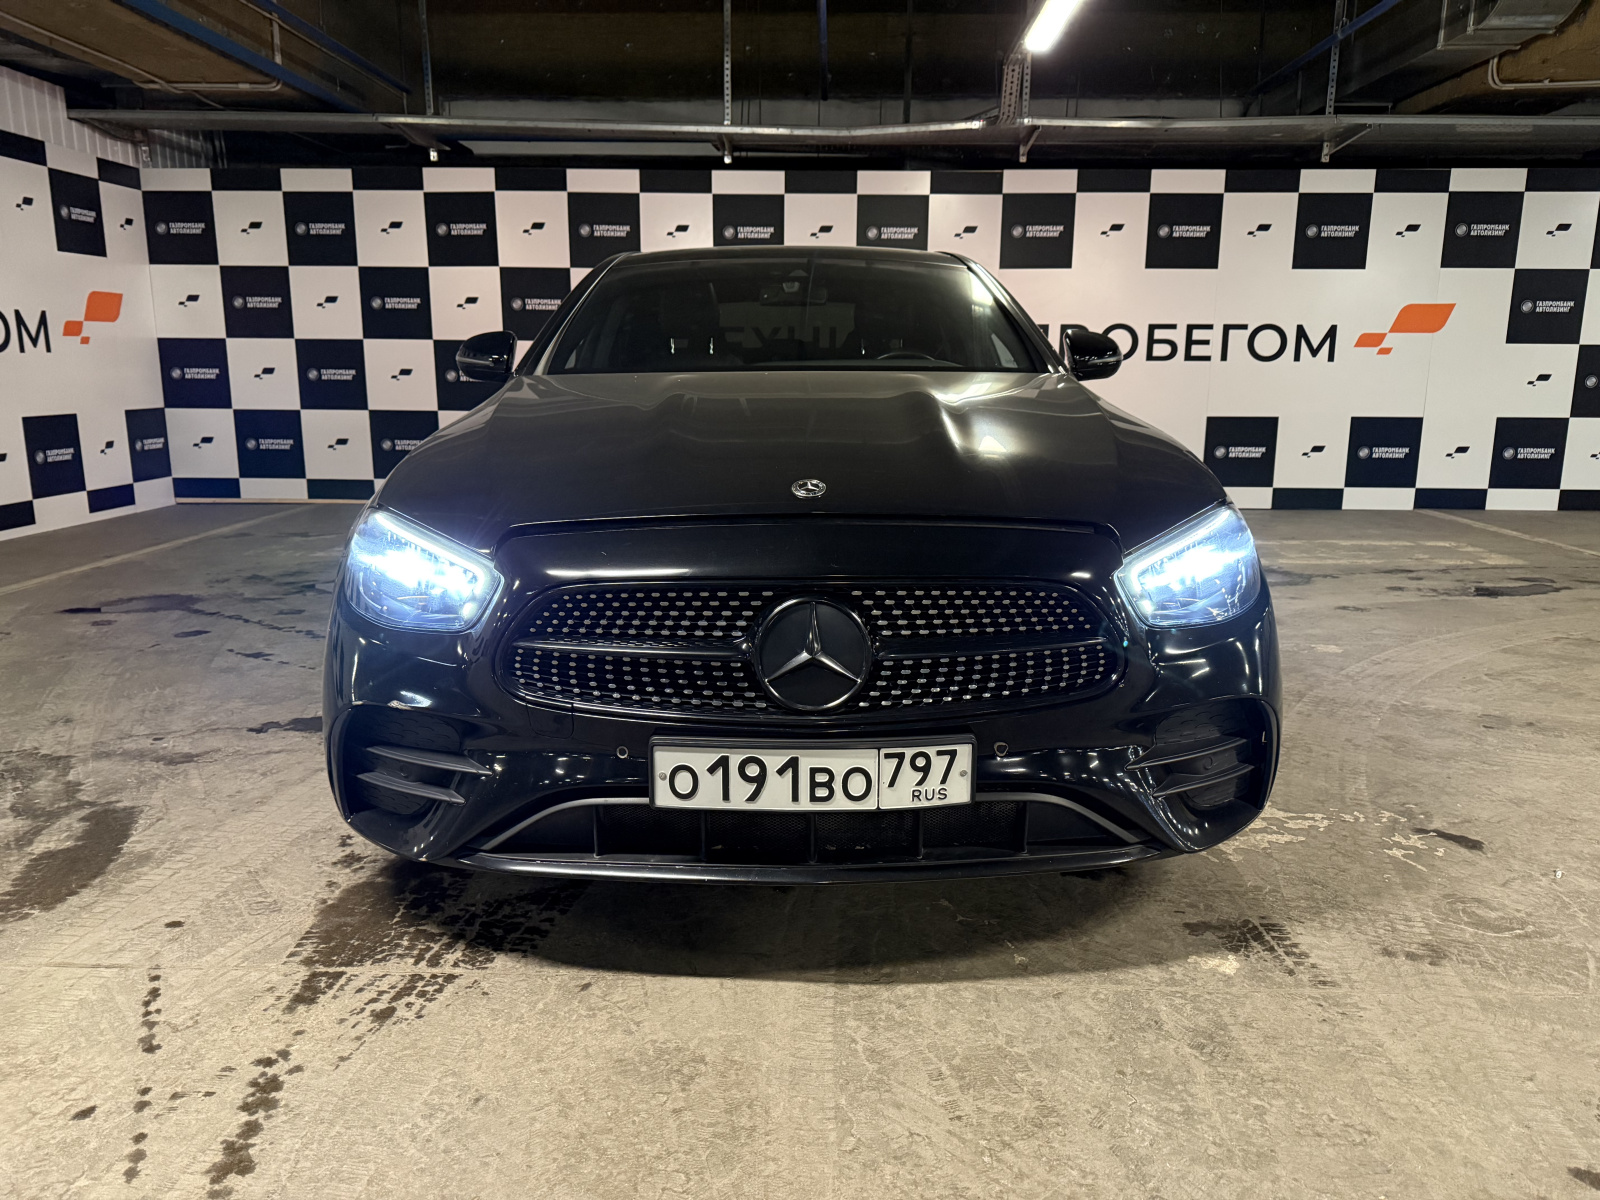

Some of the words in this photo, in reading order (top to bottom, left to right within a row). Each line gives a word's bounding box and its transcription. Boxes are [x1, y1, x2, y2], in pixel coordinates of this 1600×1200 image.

[0, 309, 52, 354] М
[883, 748, 958, 788] 797
[911, 787, 948, 802] RUS
